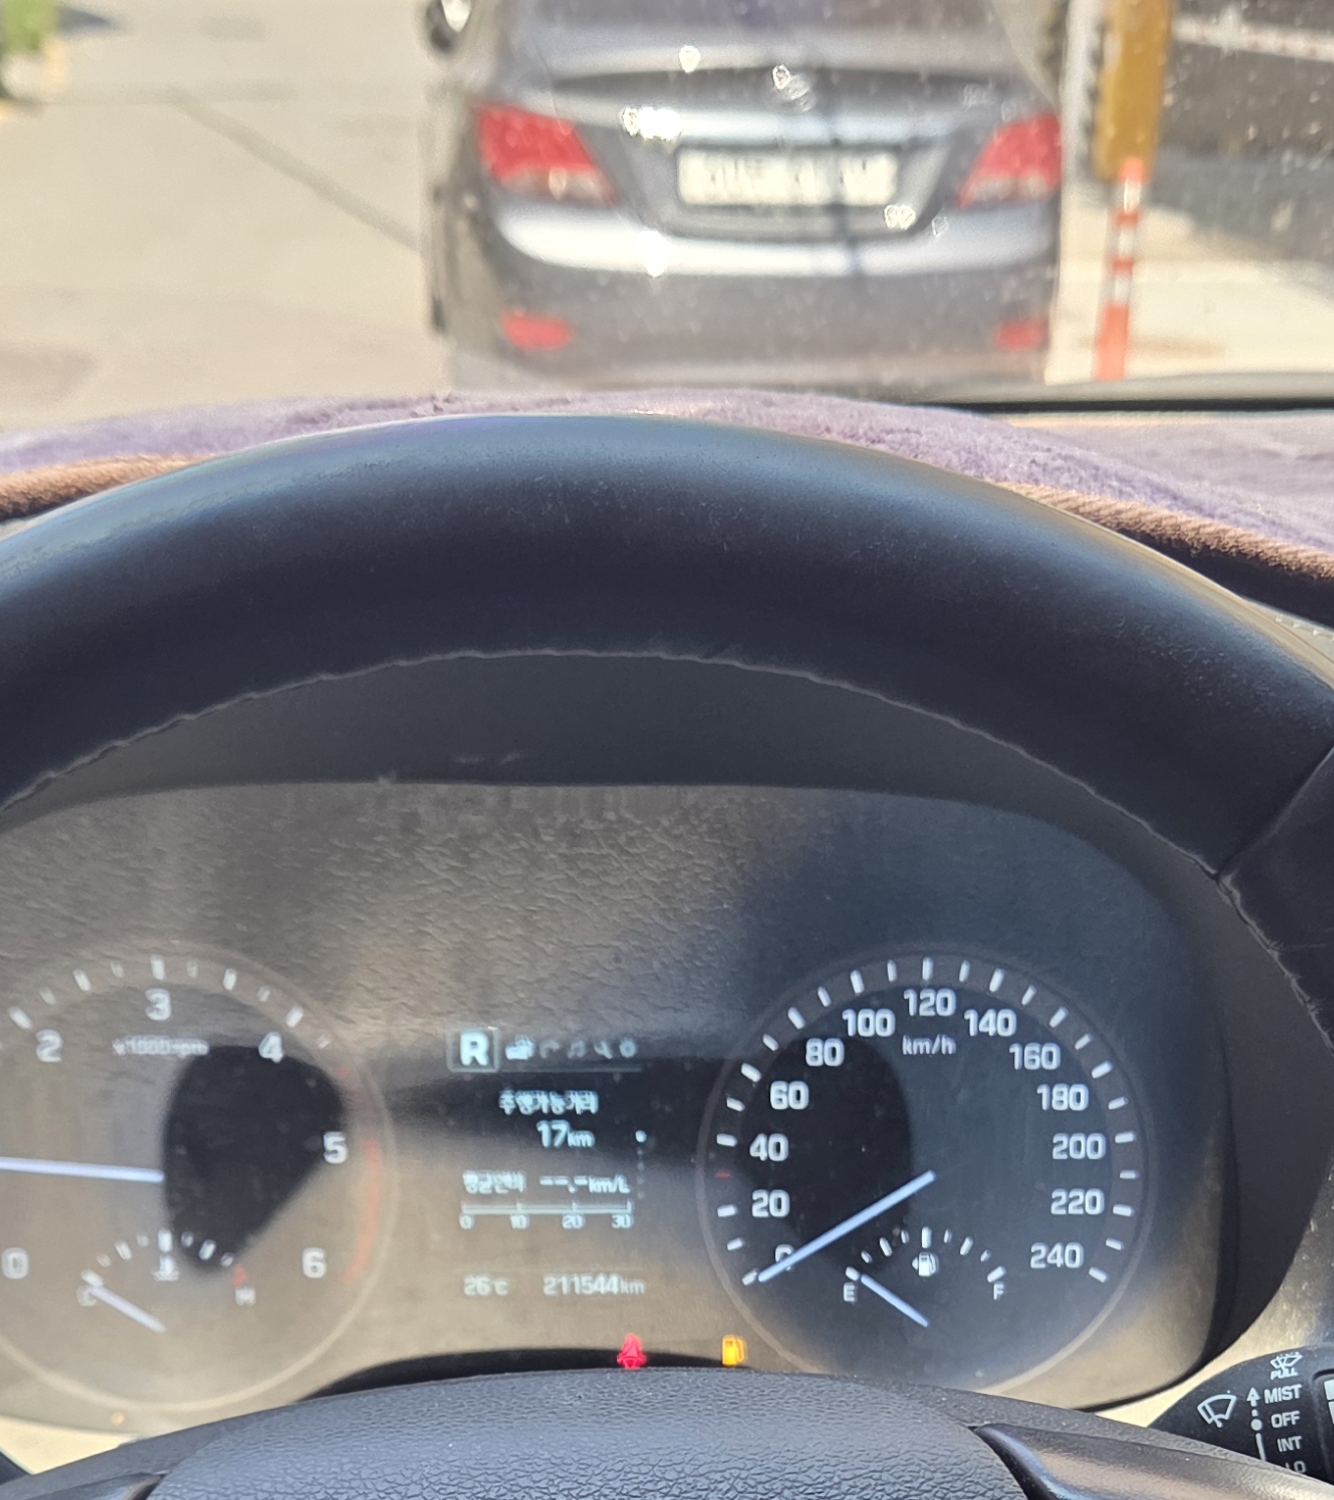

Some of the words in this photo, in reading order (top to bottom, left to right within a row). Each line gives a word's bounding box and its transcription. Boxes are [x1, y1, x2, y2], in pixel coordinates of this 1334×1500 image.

[145, 988, 172, 1020] 3
[903, 989, 956, 1016] 120
[842, 1009, 895, 1037] 100
[964, 1009, 1017, 1037] 140
[35, 1029, 63, 1062] 2
[258, 1031, 284, 1062] 4
[460, 1029, 489, 1065] R
[805, 1038, 845, 1067] 80
[902, 1034, 956, 1056] km/h
[1009, 1043, 1061, 1070] 160
[769, 1081, 809, 1110] 60
[1036, 1083, 1089, 1111] 180
[323, 1131, 348, 1164] 5
[749, 1133, 789, 1161] 40
[1052, 1133, 1105, 1160] 200
[751, 1190, 790, 1218] 20
[1051, 1188, 1105, 1216] 220
[510, 1213, 529, 1229] 10
[561, 1213, 585, 1229] 20
[611, 1213, 634, 1229] 30
[1, 1247, 29, 1279] 0
[302, 1247, 327, 1278] 6
[1030, 1243, 1084, 1269] 240
[843, 1283, 858, 1302] E
[992, 1282, 1006, 1300] F
[1270, 1367, 1299, 1380] PULL
[1264, 1385, 1302, 1404] MIST
[1270, 1411, 1300, 1428] OFF
[1277, 1436, 1302, 1452] INT
